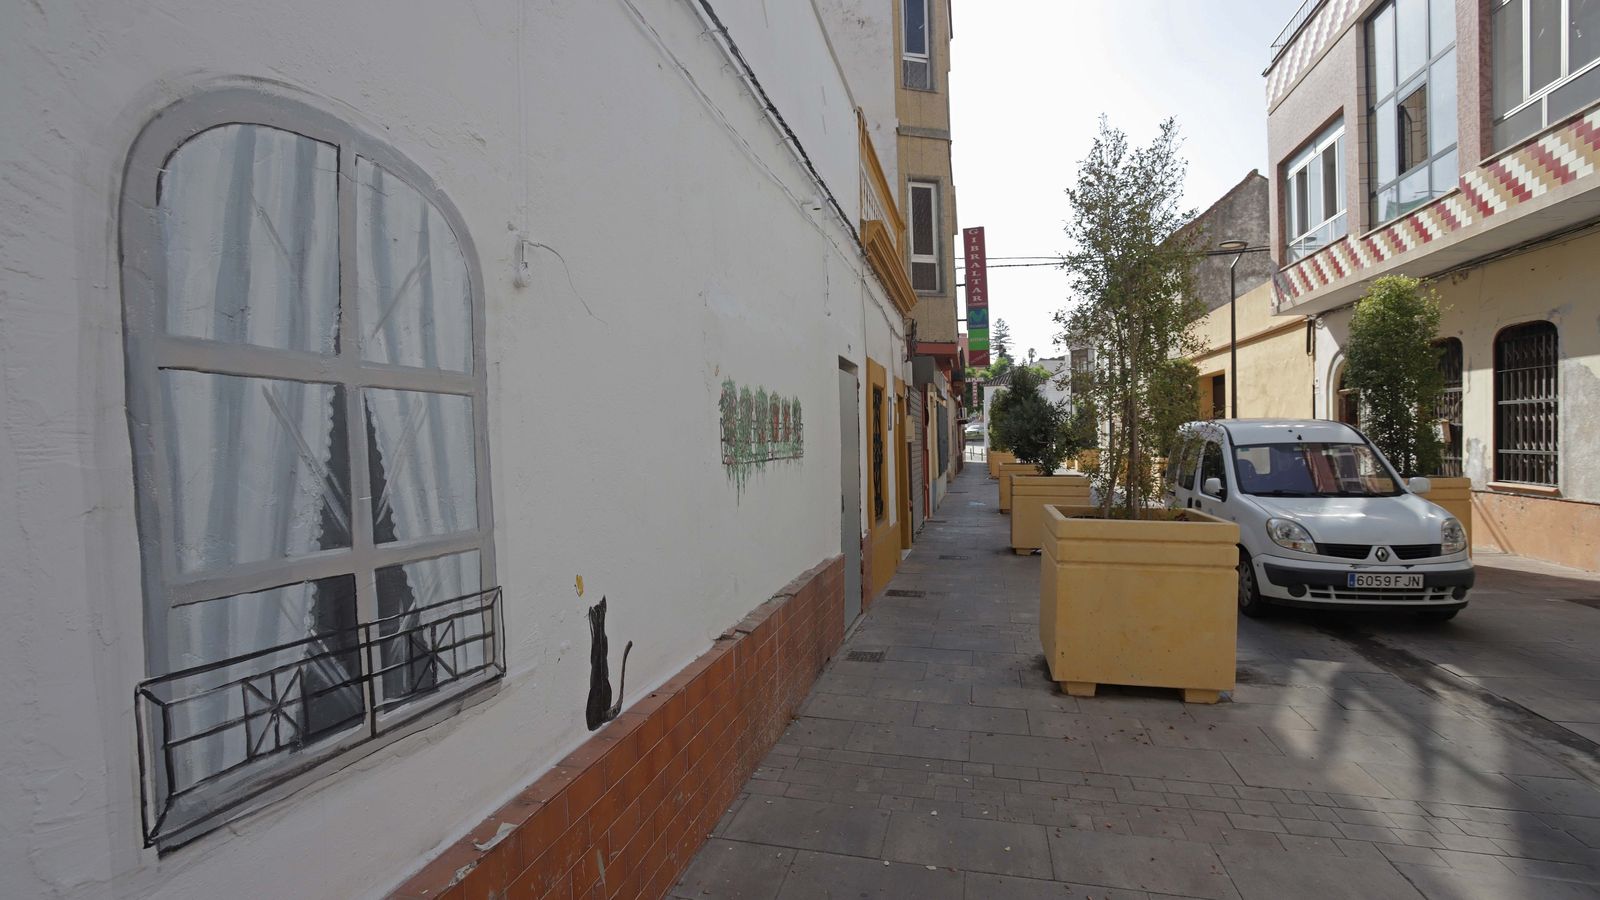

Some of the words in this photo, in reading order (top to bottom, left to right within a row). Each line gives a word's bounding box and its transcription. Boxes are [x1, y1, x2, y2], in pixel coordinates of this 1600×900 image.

[968, 229, 982, 302] GIBRALTAR
[1357, 575, 1391, 587] 6059
[1394, 575, 1420, 587] FJN
